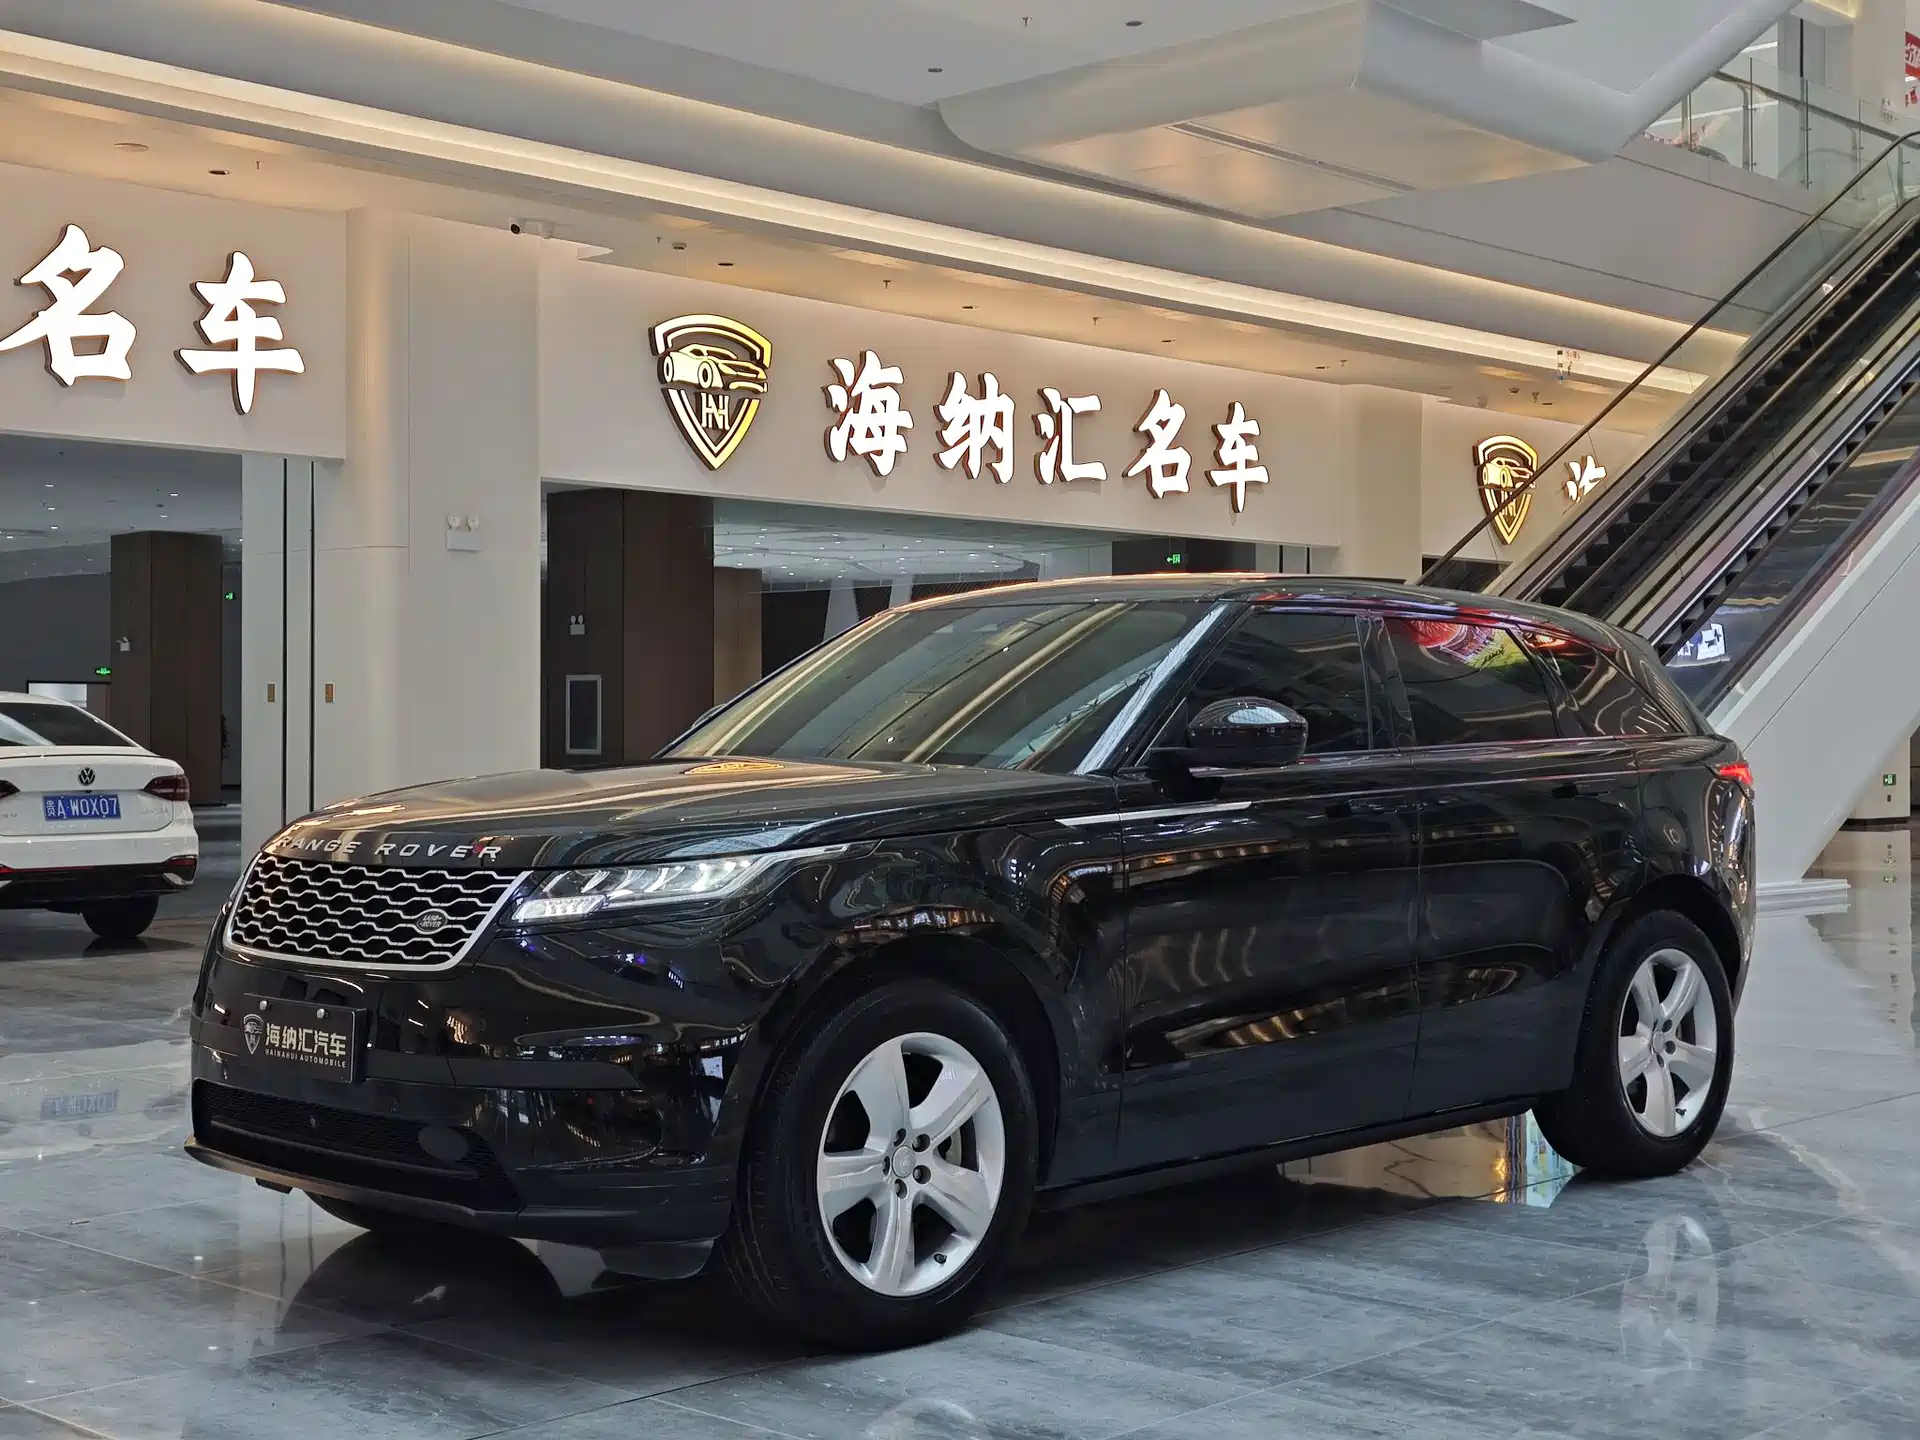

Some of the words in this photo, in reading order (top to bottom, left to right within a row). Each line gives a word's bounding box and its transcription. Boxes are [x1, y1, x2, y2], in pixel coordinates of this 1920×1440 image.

[0, 223, 305, 415] 名车
[823, 350, 1270, 513] 海纳汇名车
[276, 836, 361, 853] RANGE
[374, 843, 502, 860] ROVER
[265, 1023, 347, 1057] 海纳汇汽车
[299, 1053, 346, 1068] AUTOMOBILE
